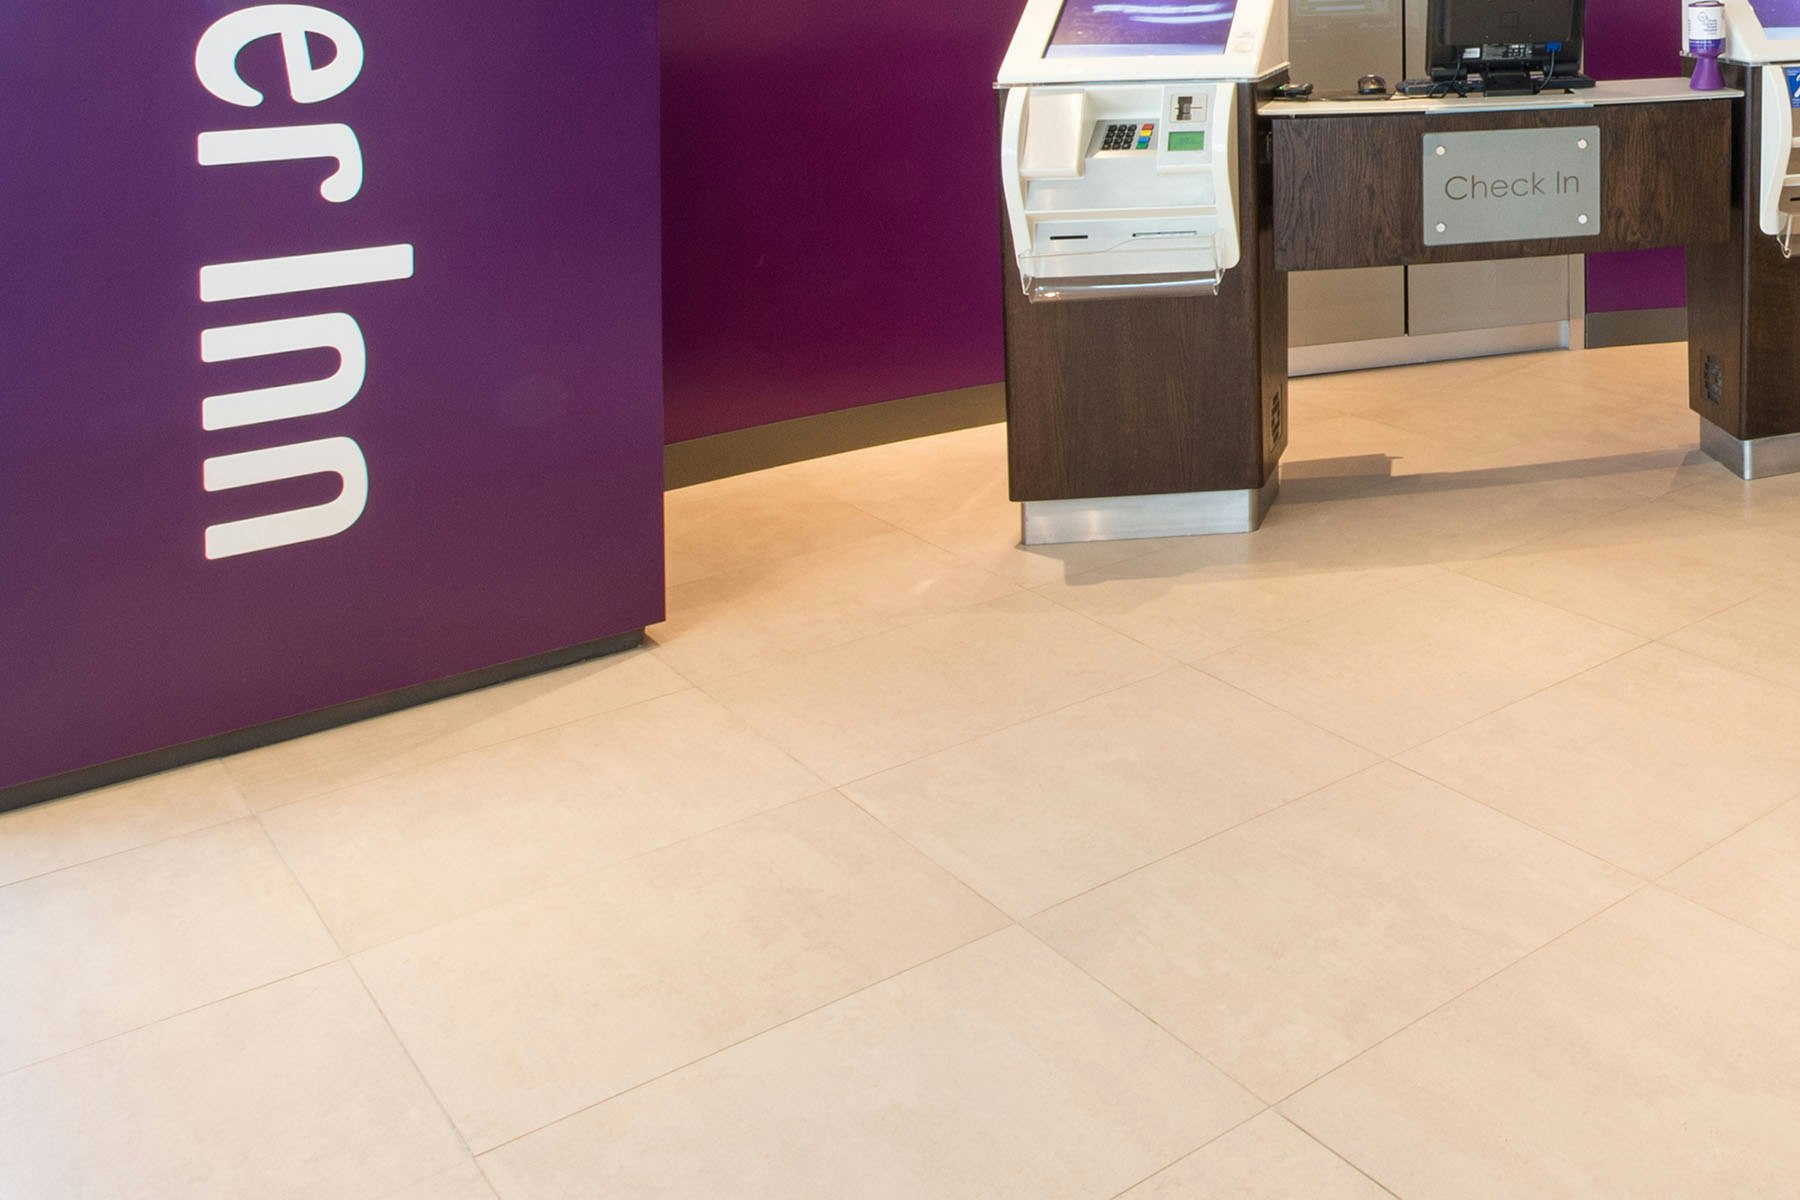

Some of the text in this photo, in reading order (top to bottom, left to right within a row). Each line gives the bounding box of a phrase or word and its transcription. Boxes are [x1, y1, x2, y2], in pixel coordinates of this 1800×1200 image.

[1444, 170, 1579, 200] Check In
[200, 243, 414, 561] Inn
